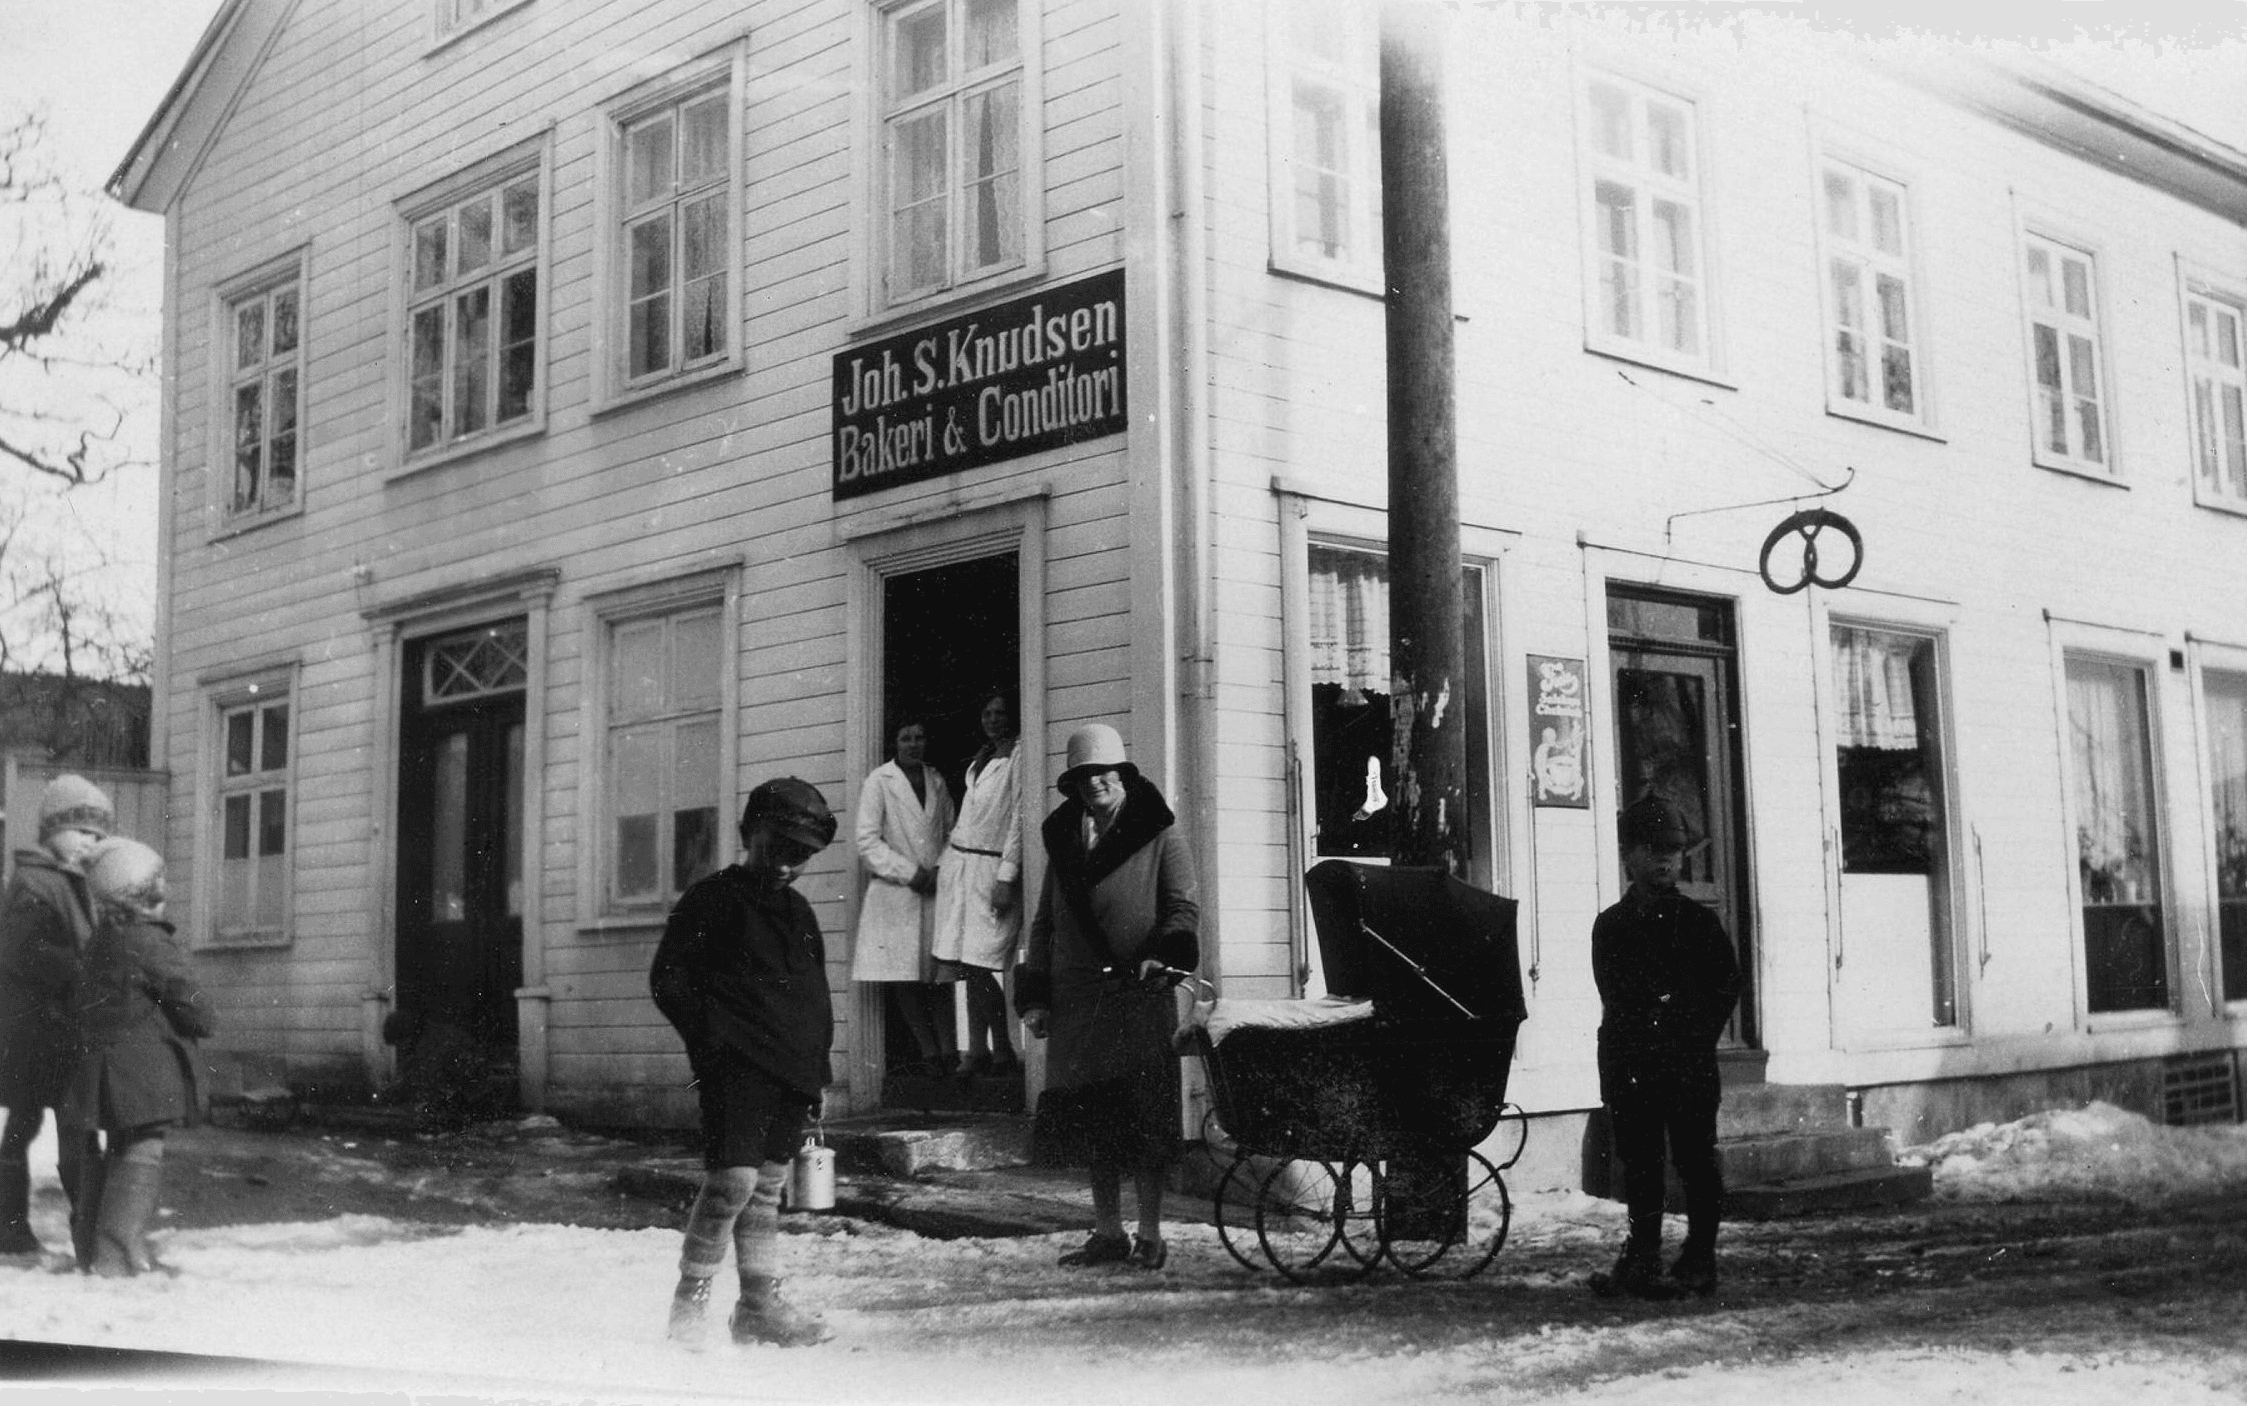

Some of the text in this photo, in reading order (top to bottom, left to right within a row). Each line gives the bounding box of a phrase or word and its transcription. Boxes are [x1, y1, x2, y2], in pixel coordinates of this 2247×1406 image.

[839, 350, 1120, 483] Bakeri & Conditori
[842, 300, 1118, 416] Joh. S. Knudsen
